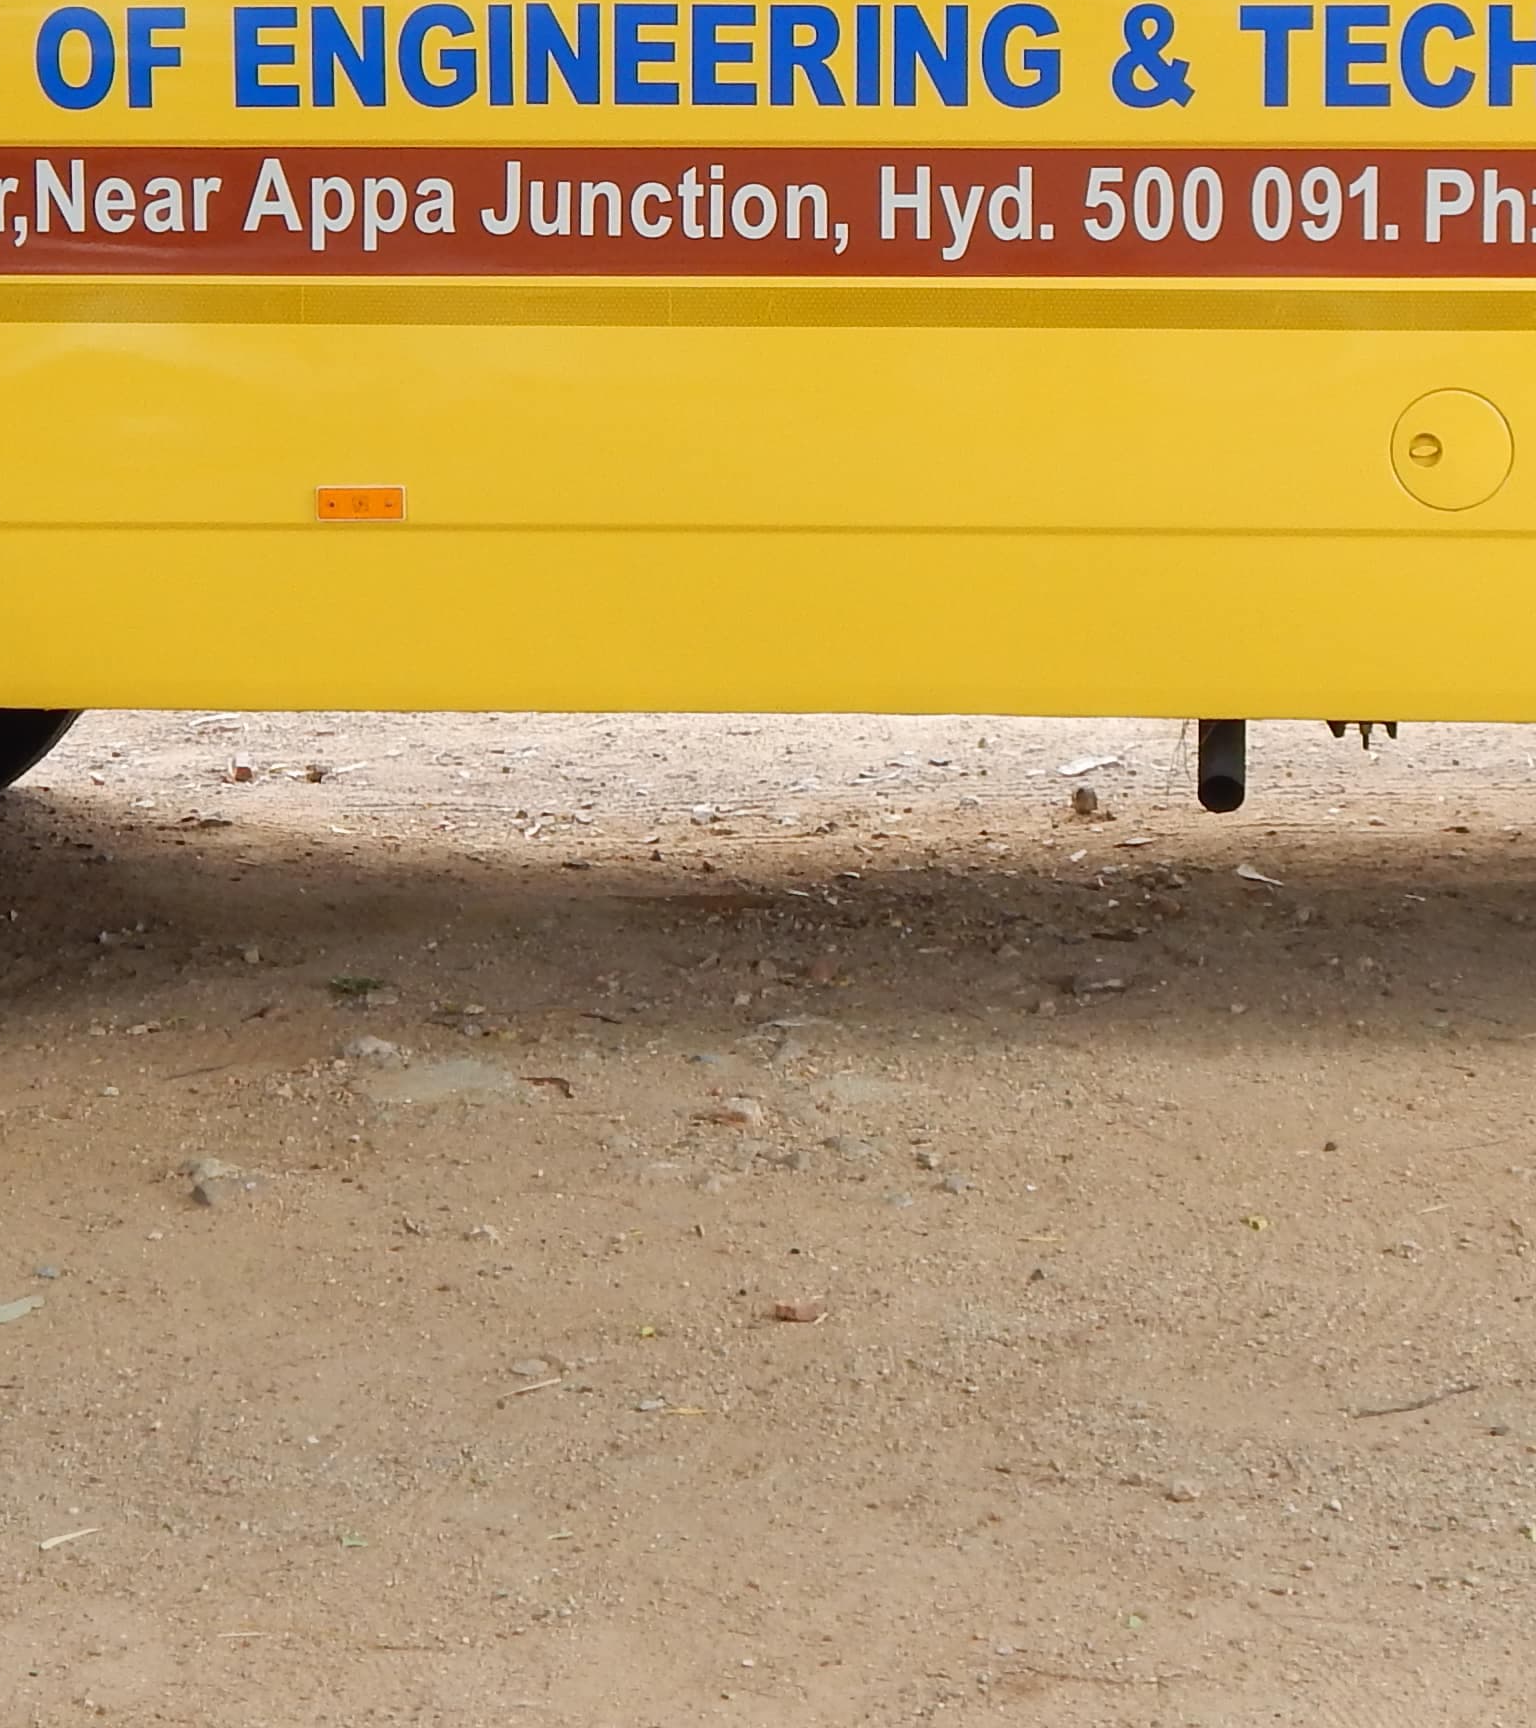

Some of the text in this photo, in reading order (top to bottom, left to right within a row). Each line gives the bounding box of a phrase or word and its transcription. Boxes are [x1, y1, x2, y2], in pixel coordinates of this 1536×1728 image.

[37, 7, 185, 109] OF
[234, 4, 1060, 108] ENGINEERING
[1112, 4, 1195, 107] &
[243, 158, 455, 252] Appa
[480, 160, 849, 255] Junction,
[880, 165, 1054, 261] Hyd.
[1083, 166, 1223, 242] 500
[1251, 165, 1399, 242] 091.
